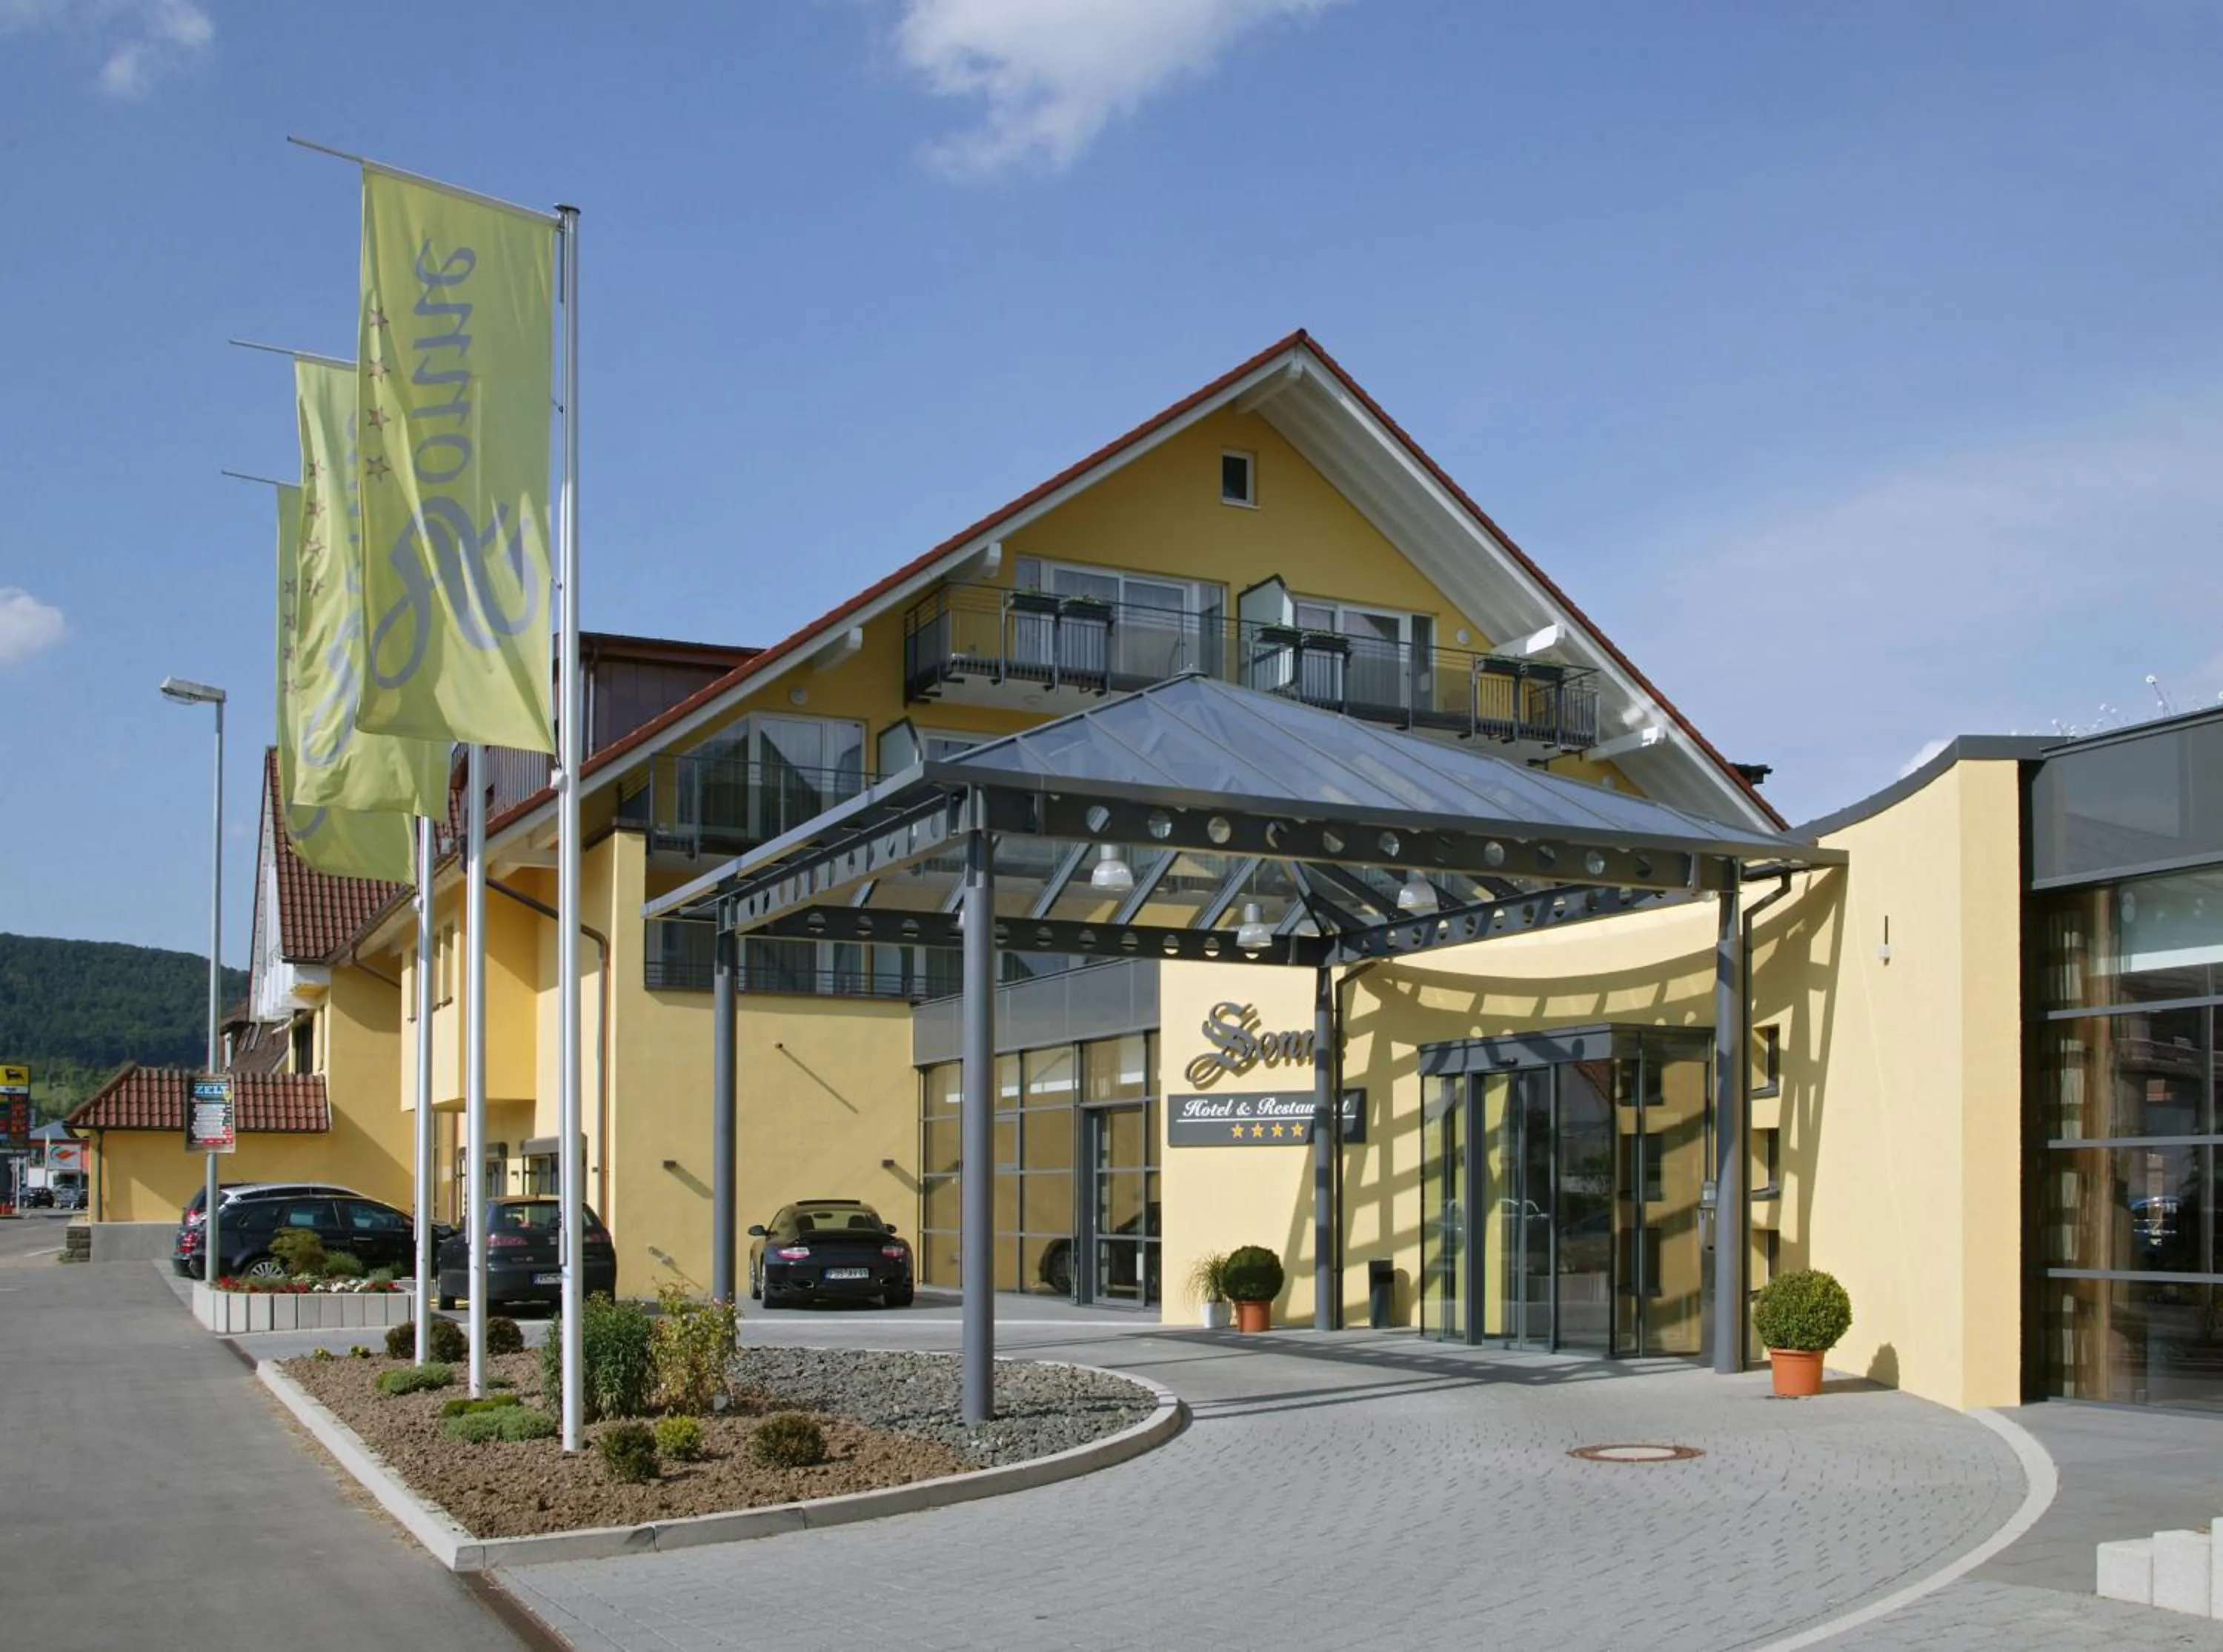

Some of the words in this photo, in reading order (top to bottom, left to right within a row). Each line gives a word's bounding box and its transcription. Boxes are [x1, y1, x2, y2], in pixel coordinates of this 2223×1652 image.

[1184, 1002, 1316, 1082] Sonn
[1183, 1099, 1234, 1116] Hotel
[1236, 1102, 1252, 1116] &
[1257, 1096, 1350, 1115] Restaut
